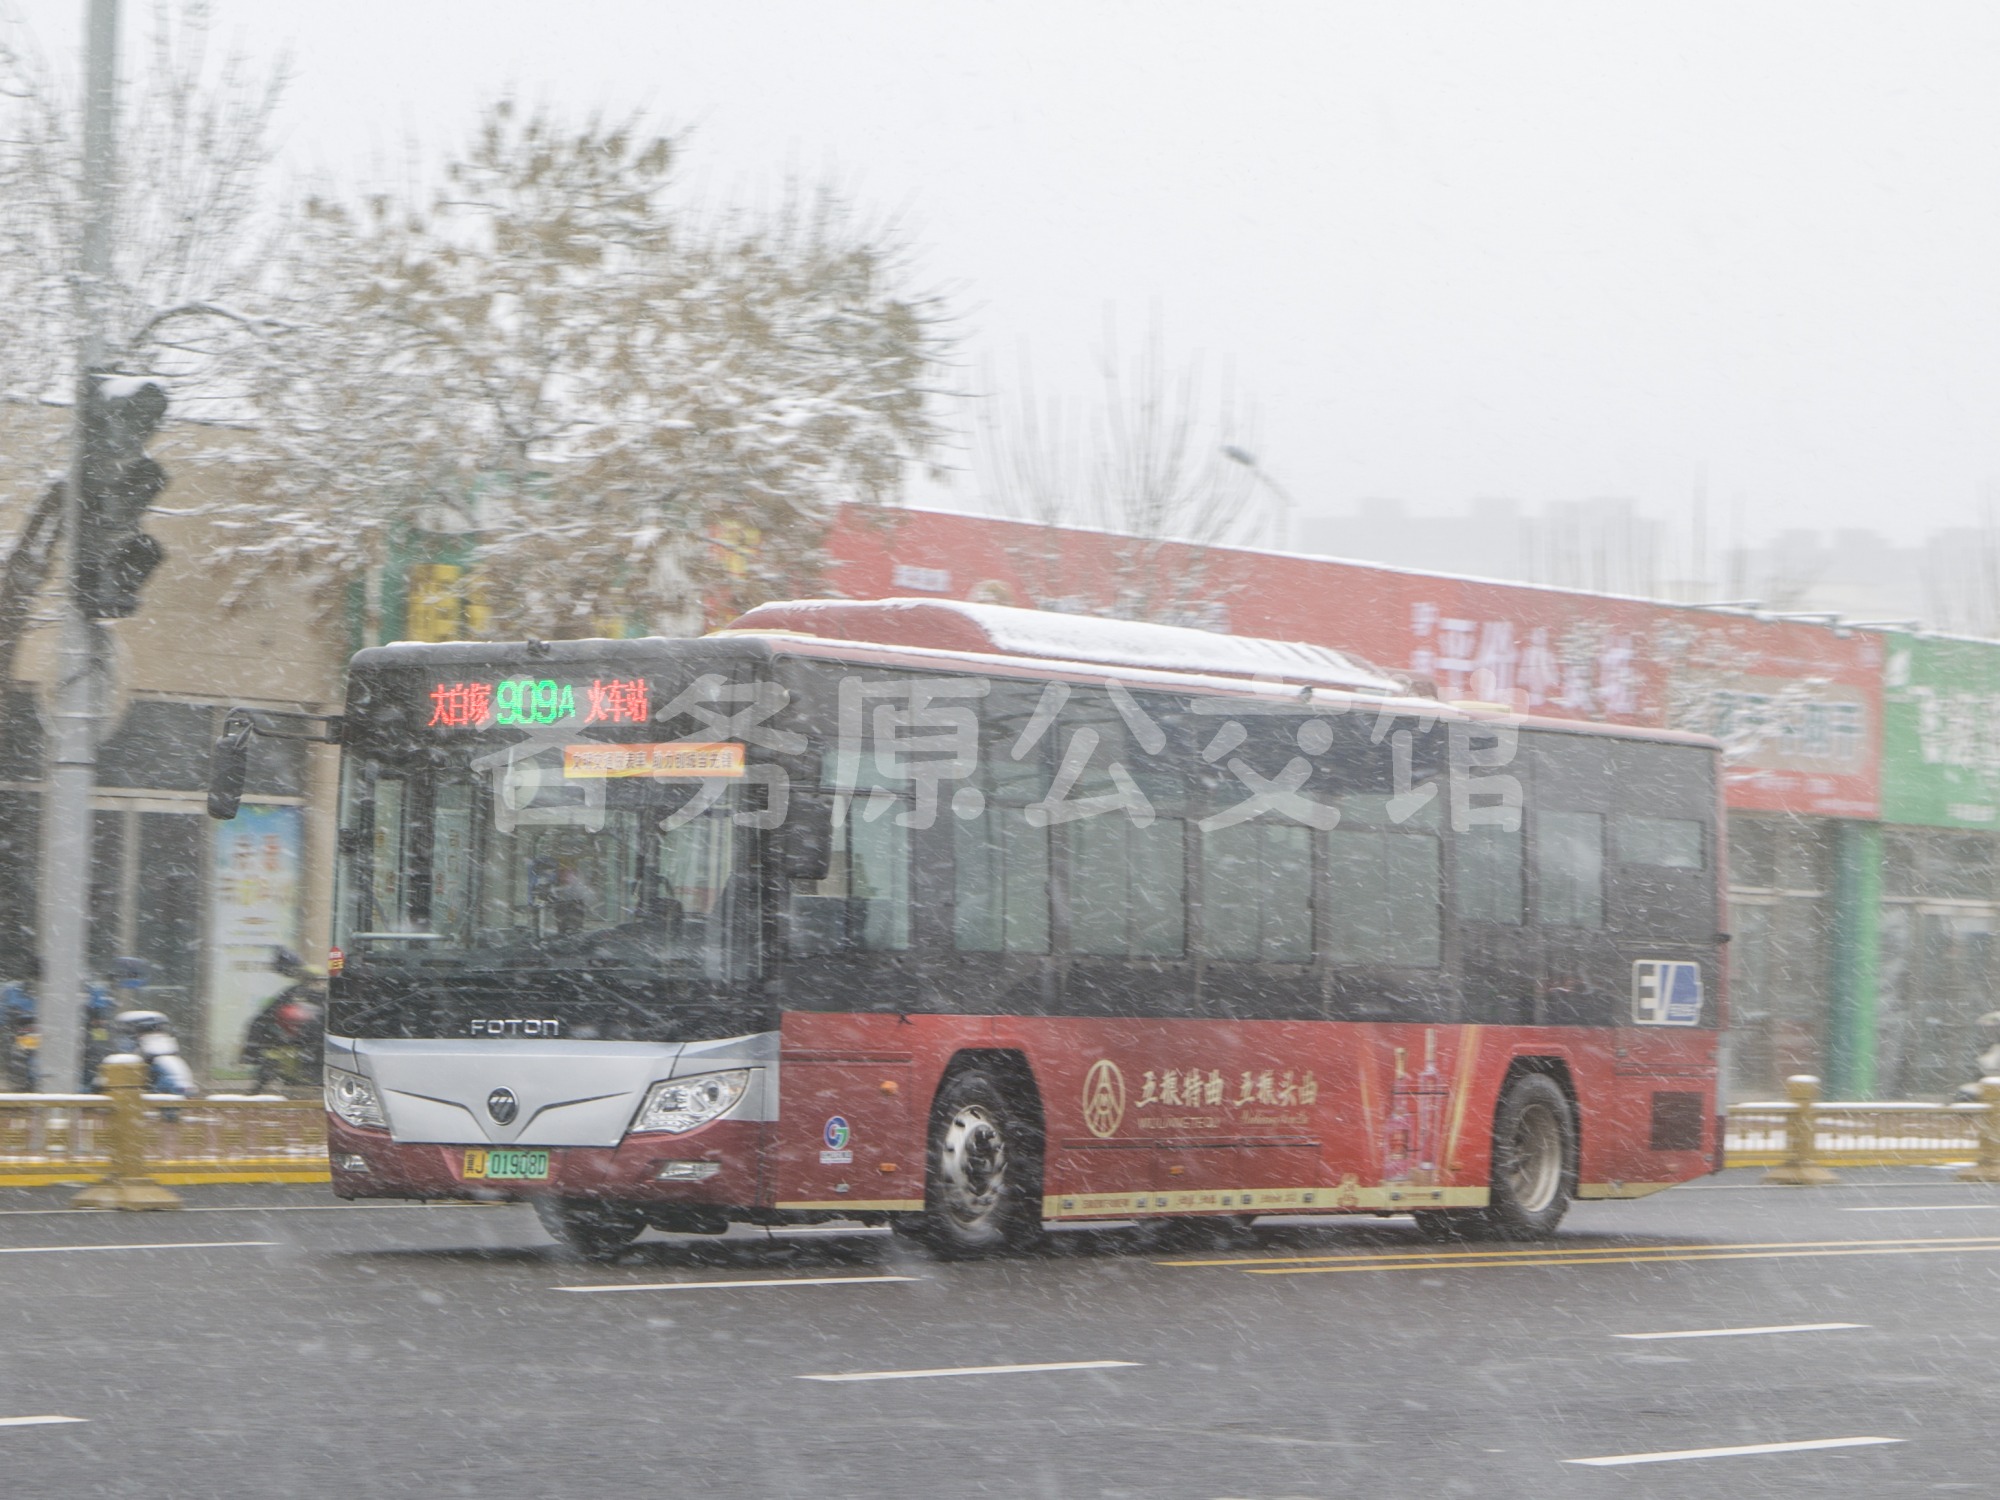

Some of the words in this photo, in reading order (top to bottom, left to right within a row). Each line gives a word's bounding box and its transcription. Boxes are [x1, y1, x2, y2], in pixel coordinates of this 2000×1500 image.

[497, 680, 576, 725] 909A
[584, 678, 649, 724] 火车站
[471, 1019, 559, 1035] FOTON
